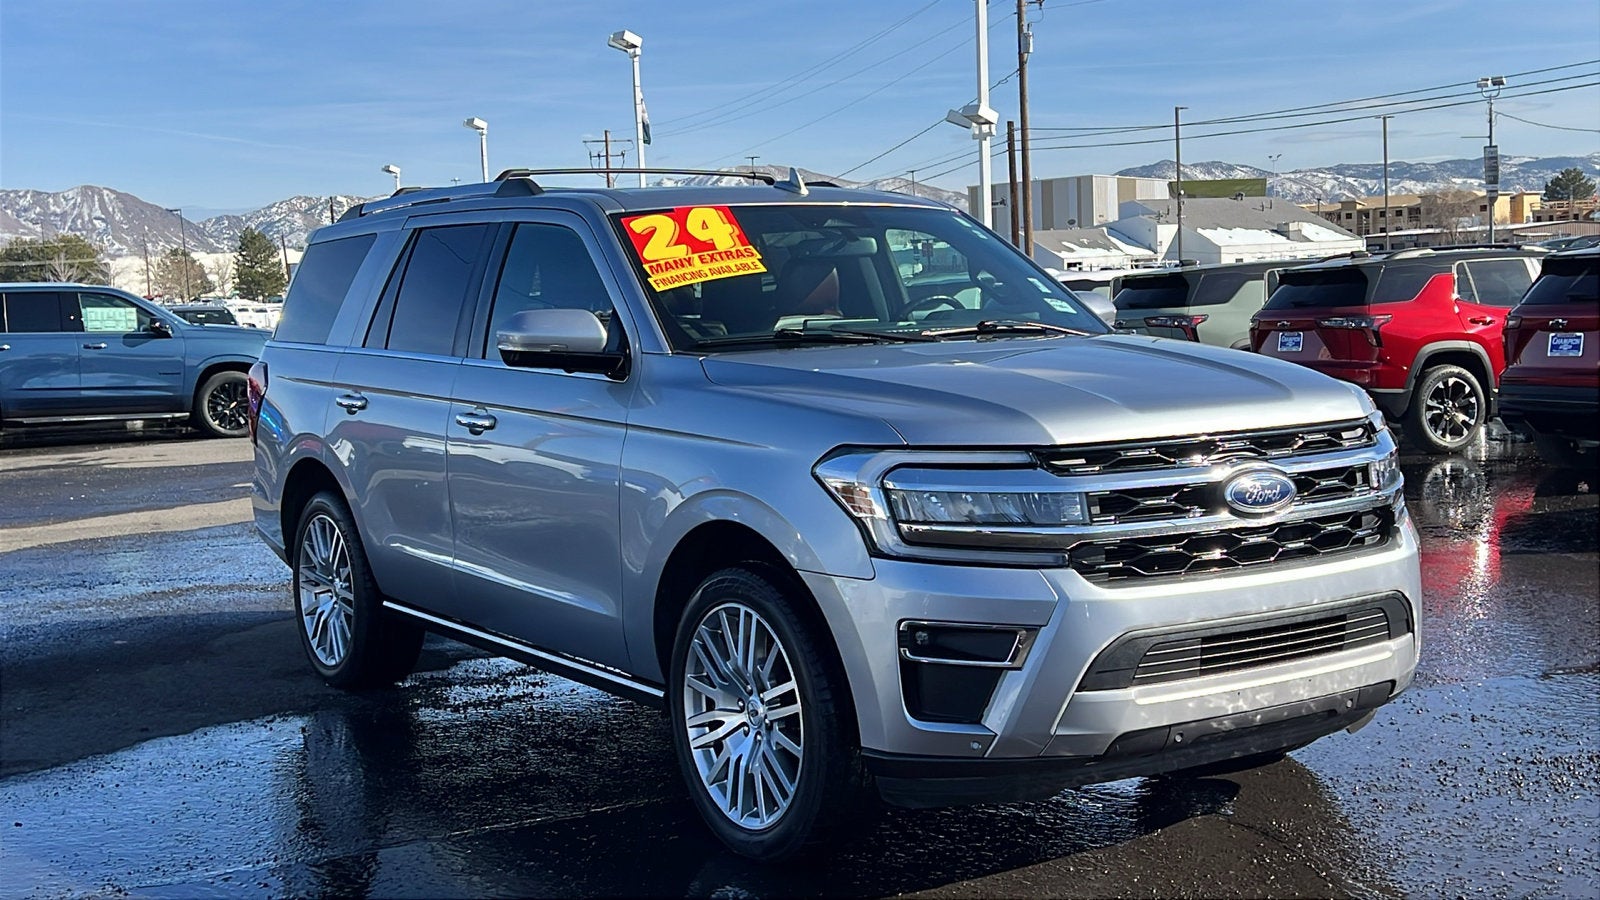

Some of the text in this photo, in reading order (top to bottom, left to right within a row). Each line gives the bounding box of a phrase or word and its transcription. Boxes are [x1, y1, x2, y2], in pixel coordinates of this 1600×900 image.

[629, 207, 739, 261] 24
[649, 247, 755, 275] MANY EXTRAS
[653, 261, 761, 288] FINANCING AVAILABLE
[1245, 484, 1281, 504] Ford
